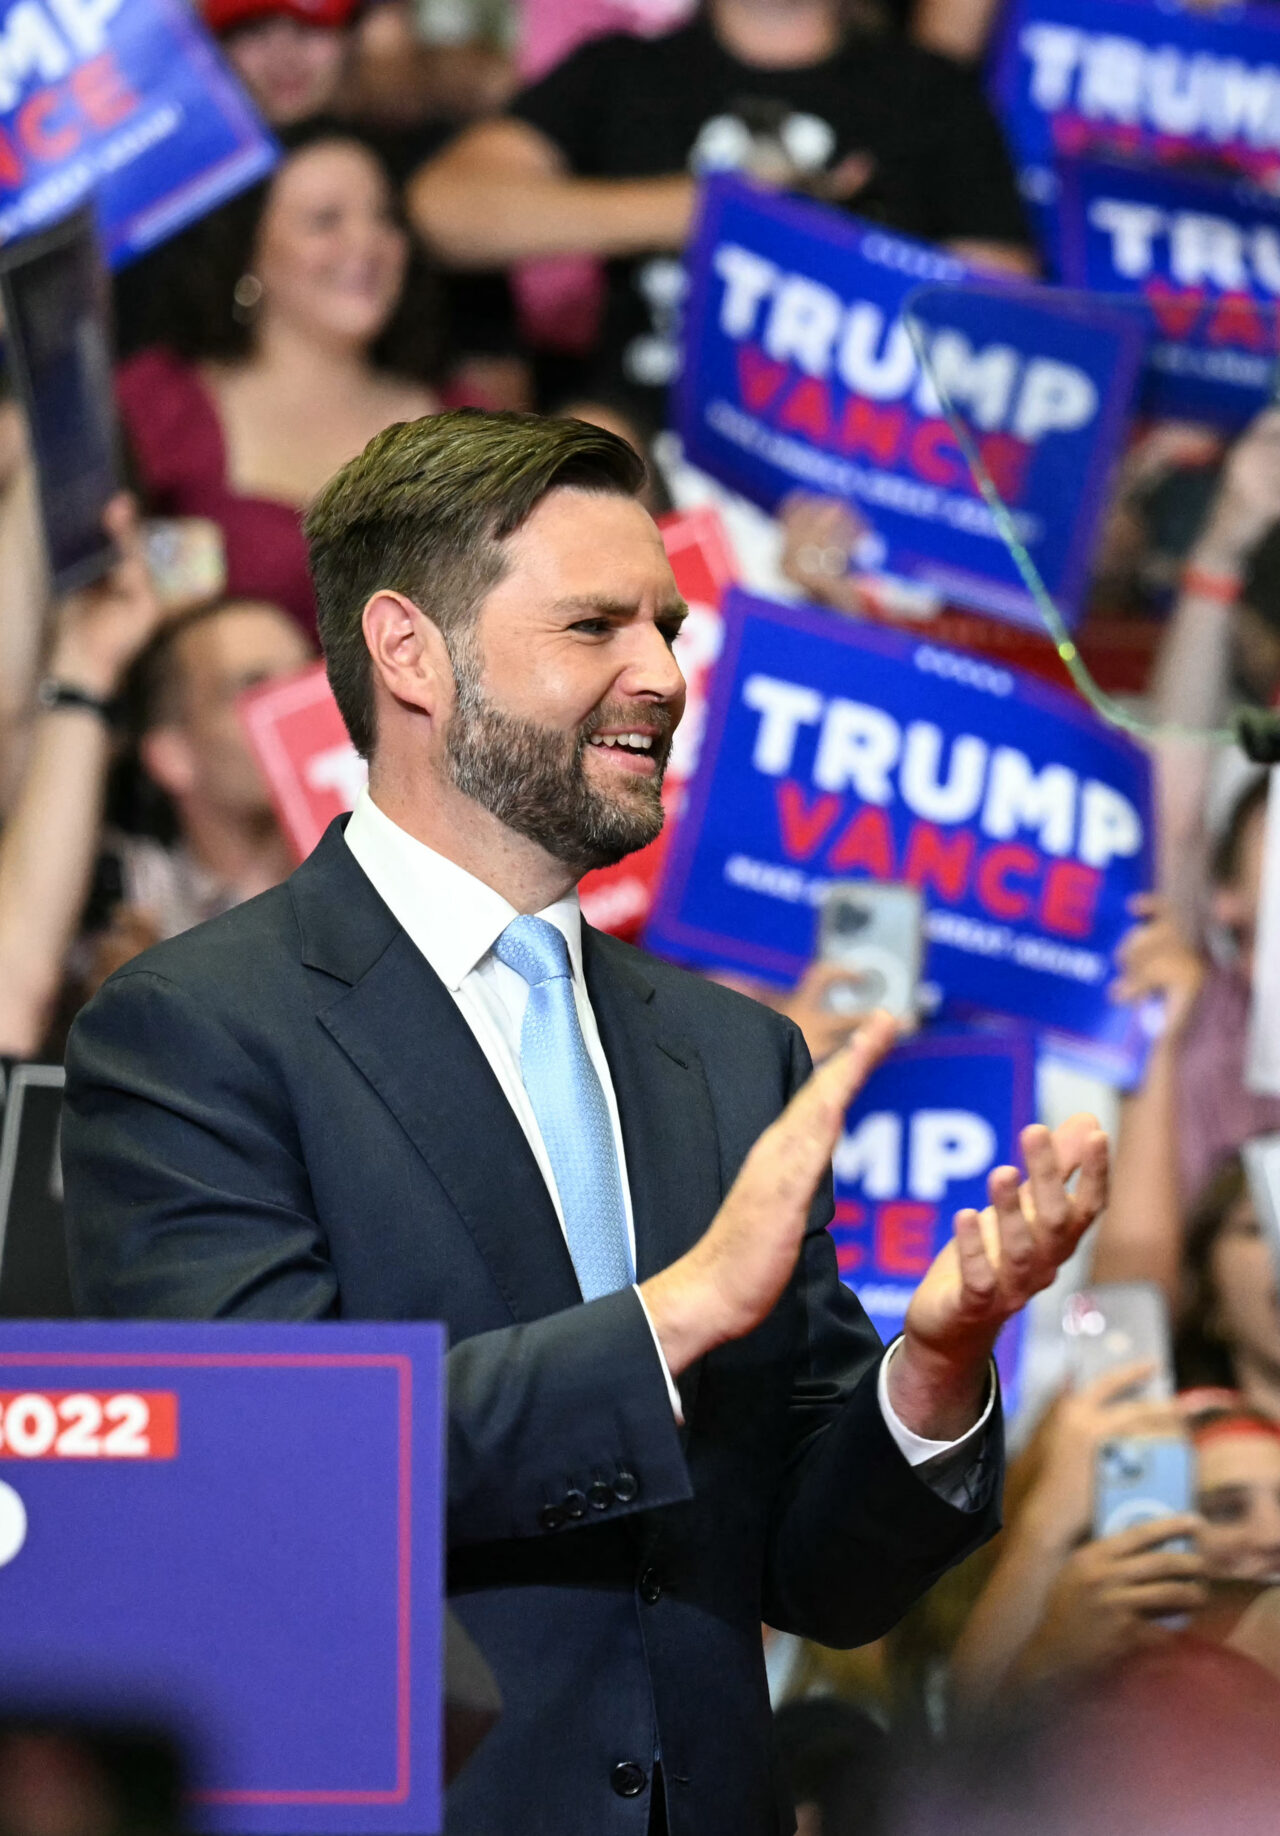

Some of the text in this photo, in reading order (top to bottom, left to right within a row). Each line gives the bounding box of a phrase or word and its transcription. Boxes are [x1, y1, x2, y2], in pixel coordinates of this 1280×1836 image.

[714, 243, 1097, 442] TRUMP
[742, 672, 1145, 869] TRUMP
[777, 777, 1103, 938] VANCE
[0, 1392, 150, 1459] 022
